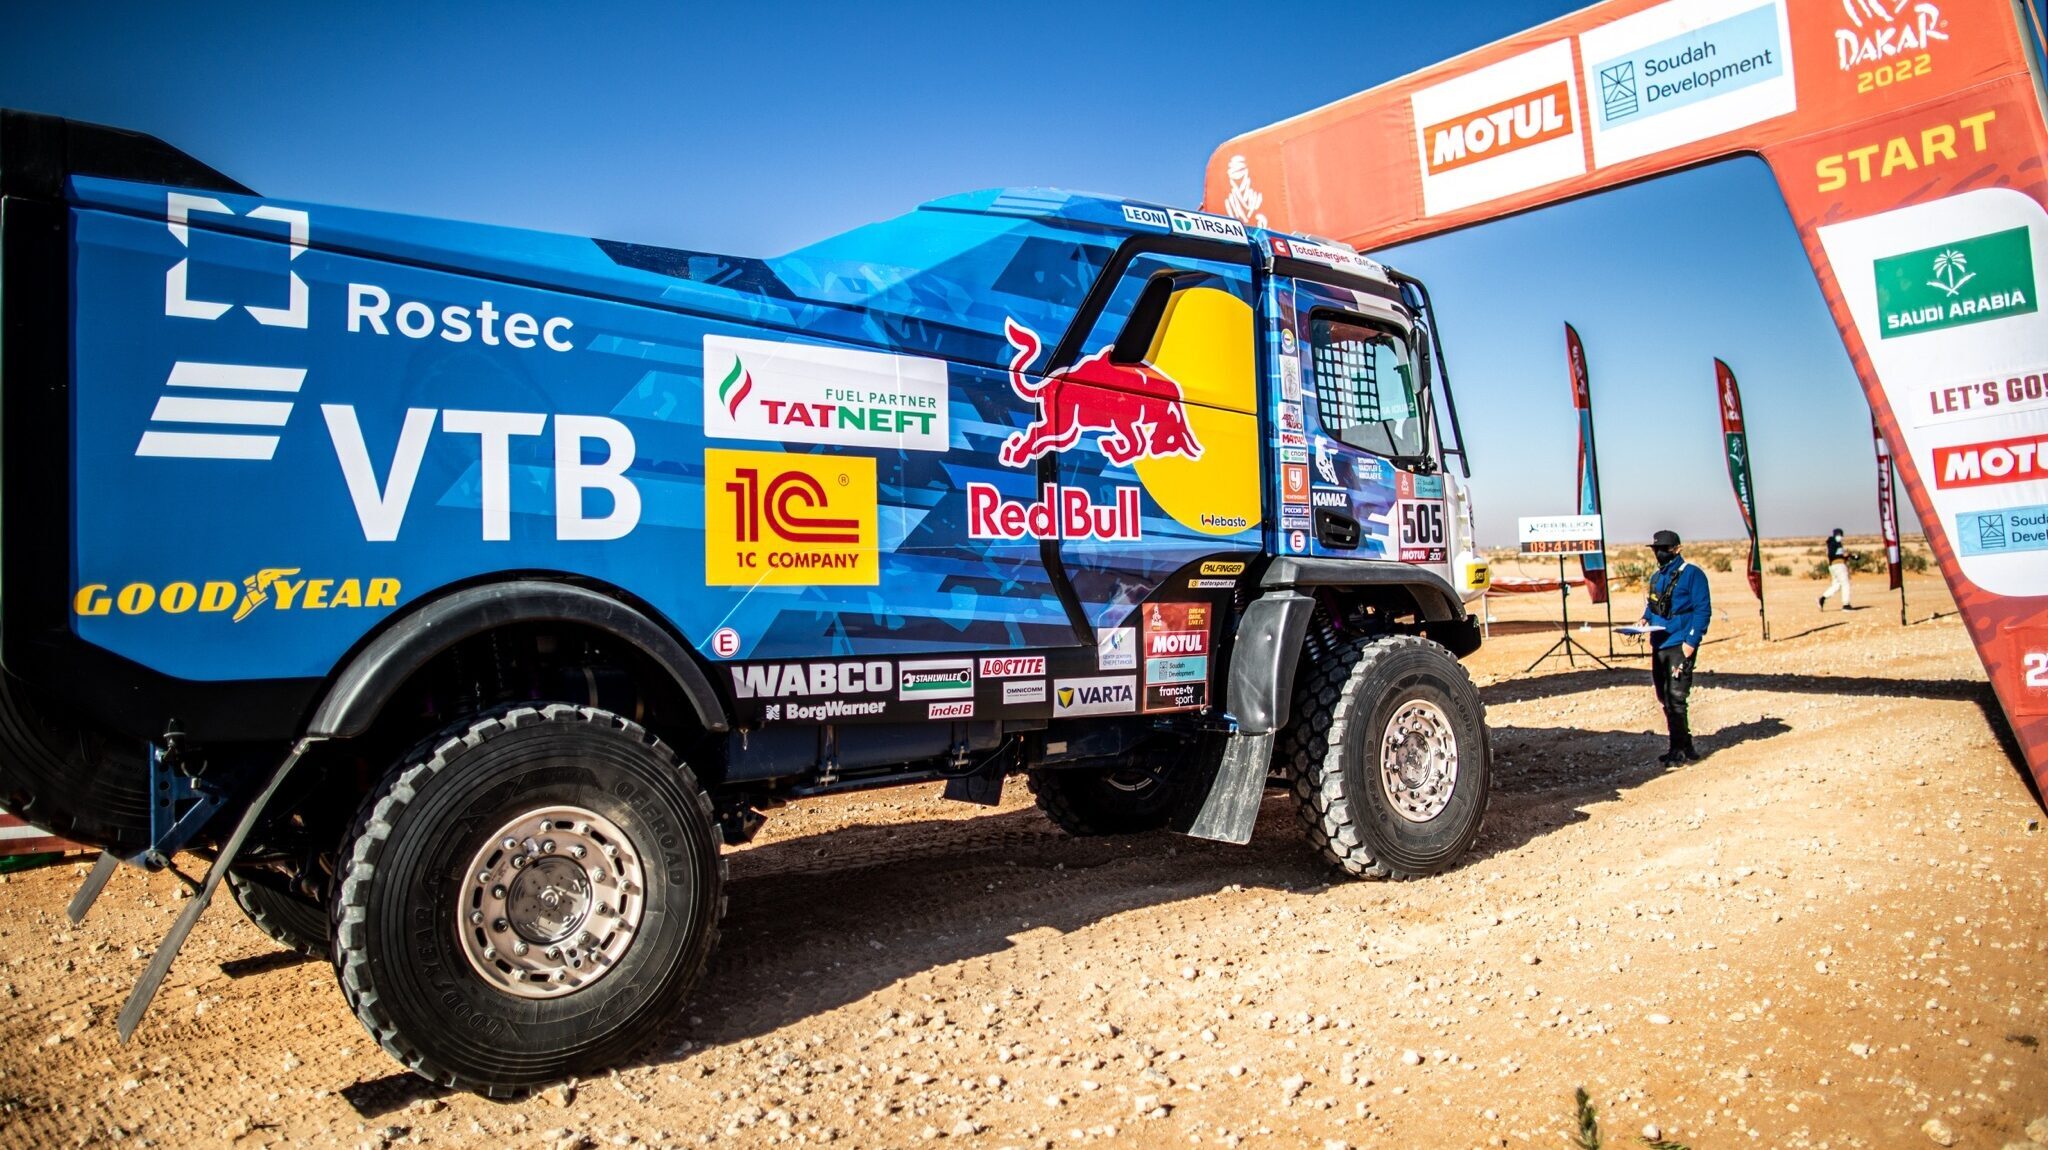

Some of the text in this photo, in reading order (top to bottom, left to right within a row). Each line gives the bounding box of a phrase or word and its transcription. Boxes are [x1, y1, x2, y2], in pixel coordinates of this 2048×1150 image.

[1835, 3, 1949, 71] DAKAR
[1644, 39, 1717, 77] Soudah
[1646, 48, 1773, 103] Development
[1858, 53, 1932, 94] 2022
[1432, 94, 1563, 166] MOTUL
[1815, 110, 1996, 193] START
[1125, 207, 1167, 225] LEONI
[1292, 244, 1350, 263] TotalEnergies
[347, 283, 574, 352] Rostec
[1887, 291, 2026, 328] SAUDI ARABIA
[826, 388, 937, 409] FUEL PARTNER
[760, 400, 937, 435] TATNEFT
[320, 404, 642, 542] VTB
[1312, 492, 1347, 507] KAMAZ
[1877, 457, 1897, 545] MOTUL
[1201, 514, 1247, 528] Webasto
[1402, 504, 1443, 544] 505
[2011, 514, 2048, 527] Soud
[1294, 535, 1301, 548] E
[737, 551, 860, 569] 1C COMPANY
[1402, 551, 1426, 559] MOTUL
[1203, 564, 1242, 573] PALFINGER
[719, 634, 733, 652] E
[1152, 634, 1203, 653] MOTUL
[982, 658, 1044, 676] LOCTITE
[1168, 670, 1195, 678] Development
[731, 661, 893, 699] WABCO
[915, 672, 960, 684] STAHLWILLE
[1006, 686, 1043, 695] OMNICOMM
[1079, 685, 1133, 705] VARTA
[1175, 695, 1194, 706] sport
[786, 700, 886, 721] BorgWarner
[614, 782, 686, 888] OFFROAD
